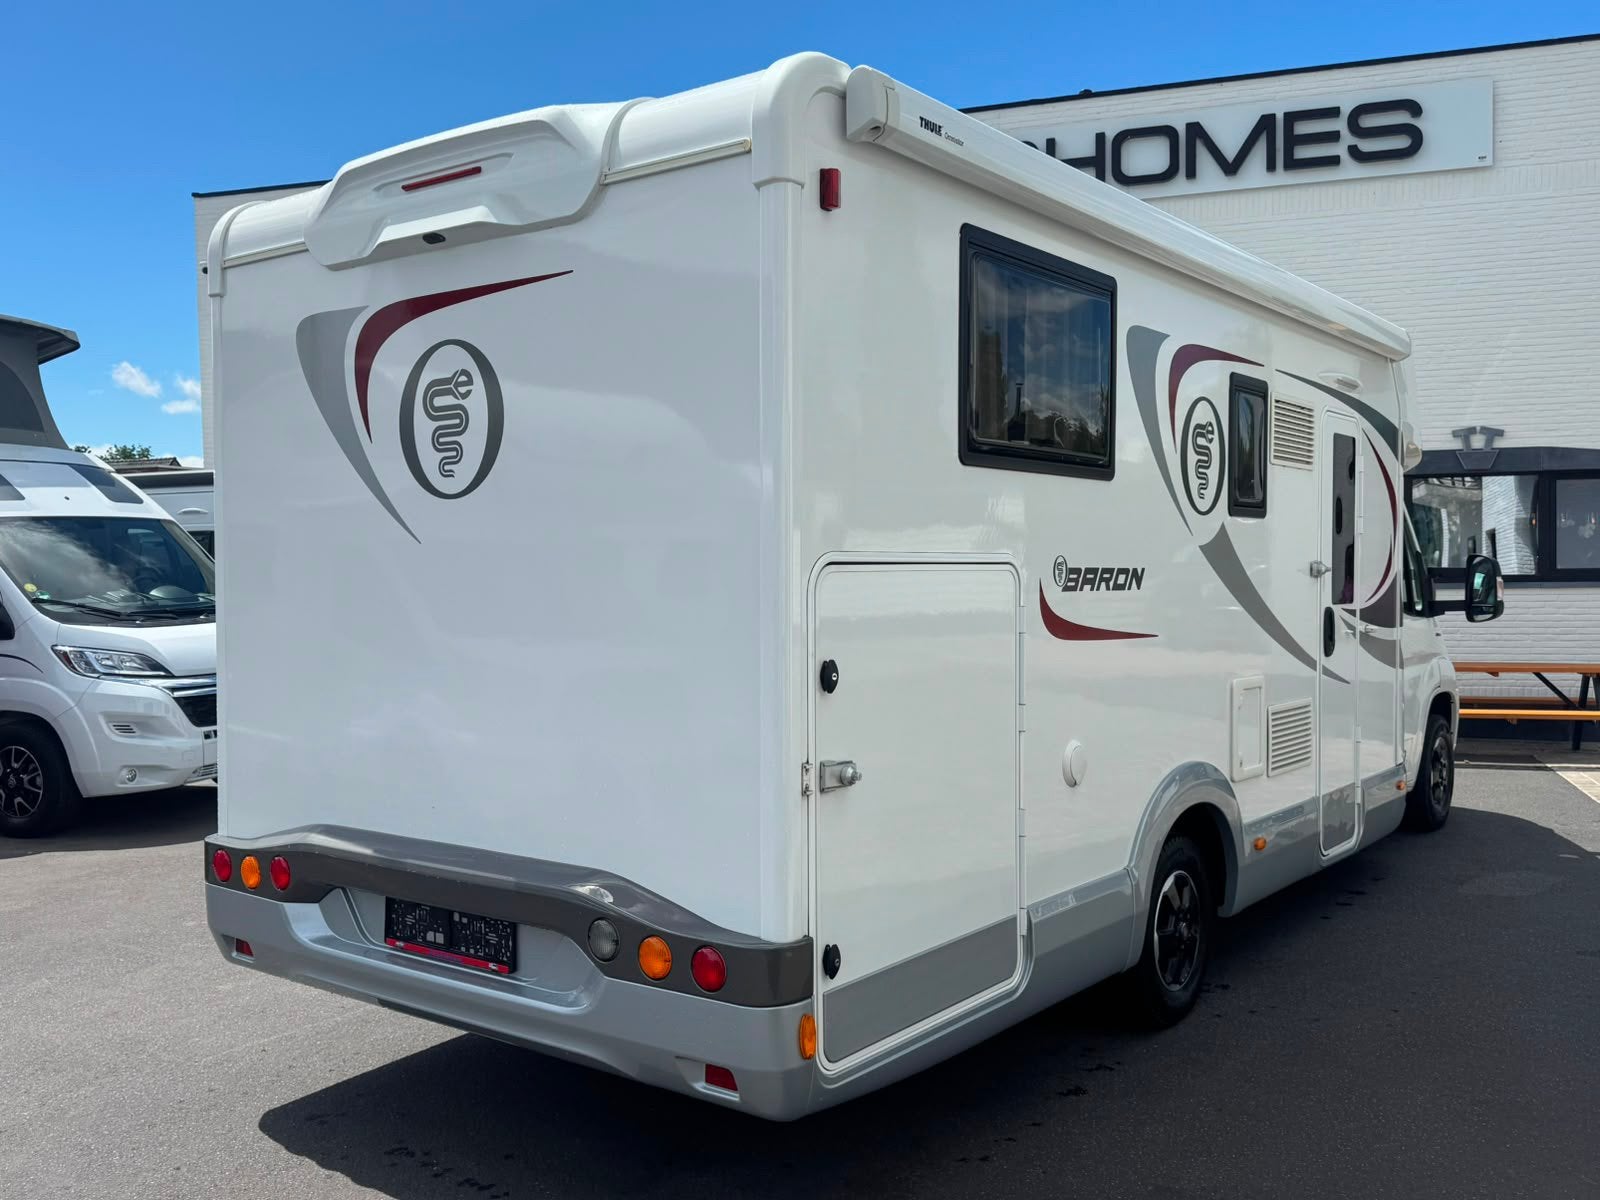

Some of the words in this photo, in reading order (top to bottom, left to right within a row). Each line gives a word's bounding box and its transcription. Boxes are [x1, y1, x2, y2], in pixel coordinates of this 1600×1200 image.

[919, 115, 942, 137] THULE
[1022, 98, 1423, 186] HOMES
[1062, 567, 1145, 592] BARON
